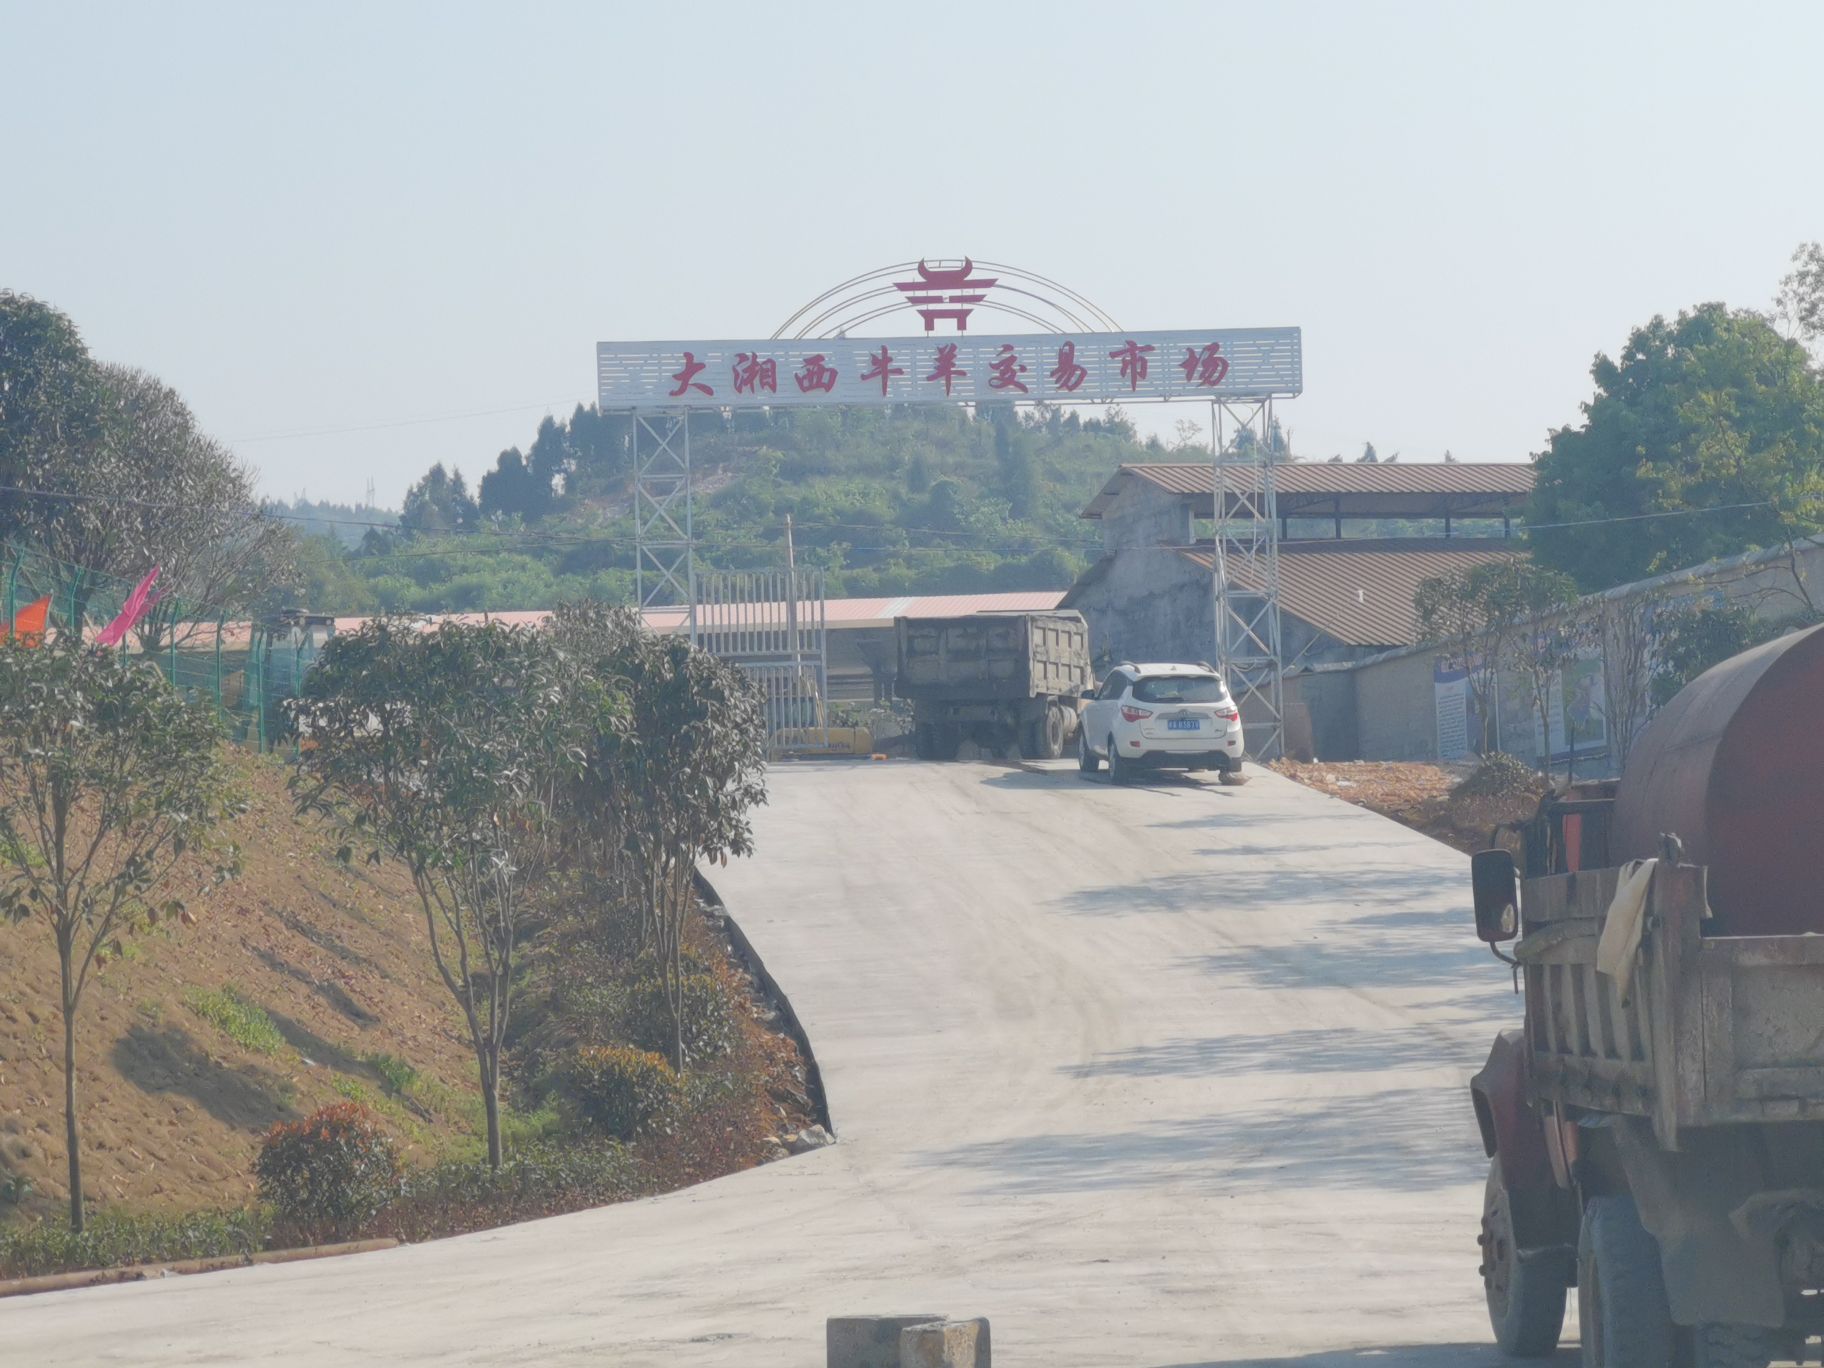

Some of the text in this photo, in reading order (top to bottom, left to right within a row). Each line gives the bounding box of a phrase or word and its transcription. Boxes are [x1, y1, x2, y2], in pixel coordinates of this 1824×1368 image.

[669, 340, 1230, 396] 大湘西牛羊交易市场
